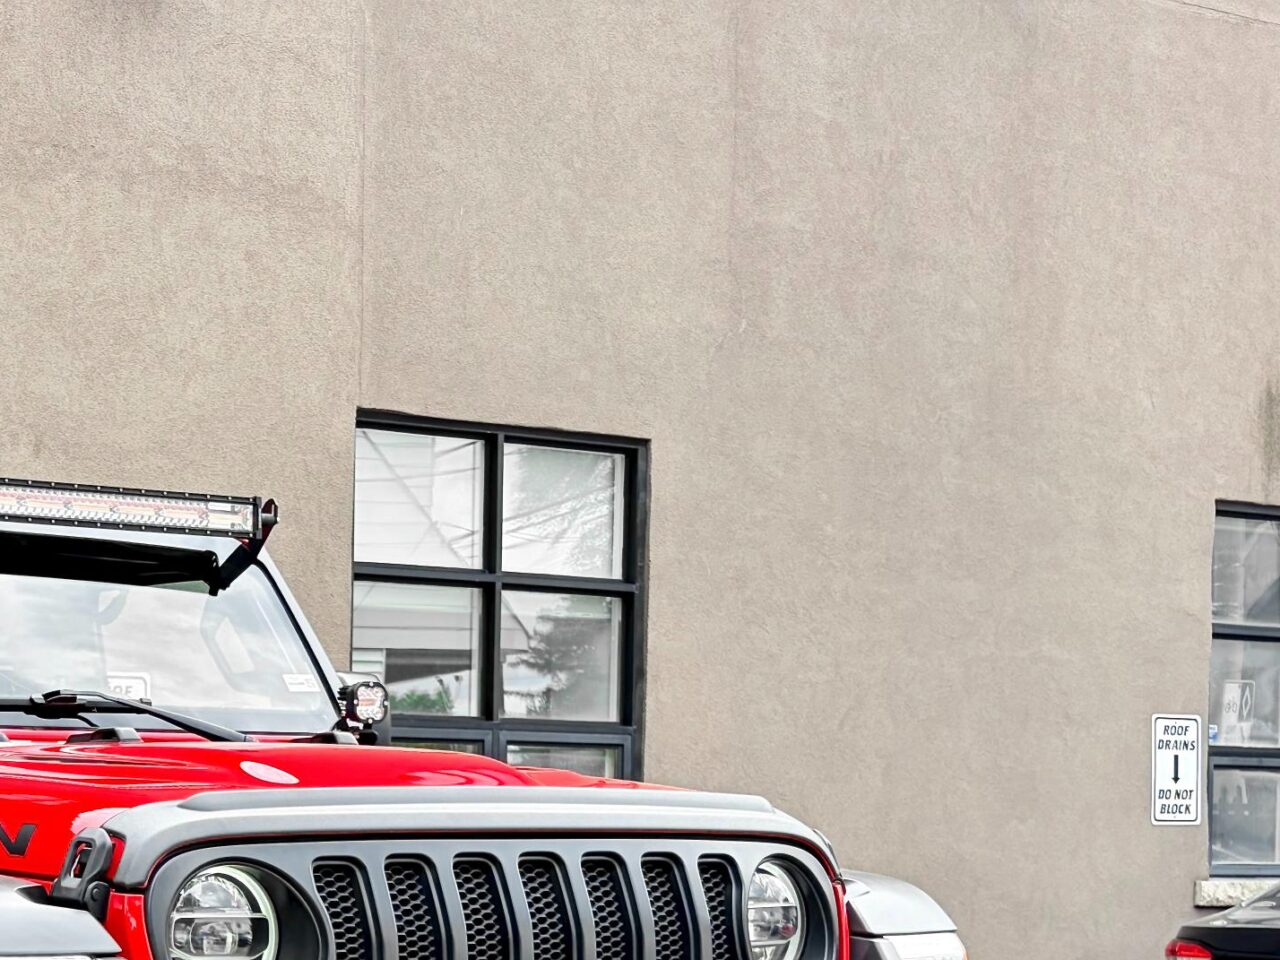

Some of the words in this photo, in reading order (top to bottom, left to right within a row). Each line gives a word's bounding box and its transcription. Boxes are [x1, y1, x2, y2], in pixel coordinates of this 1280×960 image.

[1163, 725, 1190, 736] ROOF
[1157, 739, 1196, 751] DRAINS
[1158, 789, 1172, 800] DO
[1174, 789, 1194, 800] NOT
[1160, 803, 1191, 815] BLOCK
